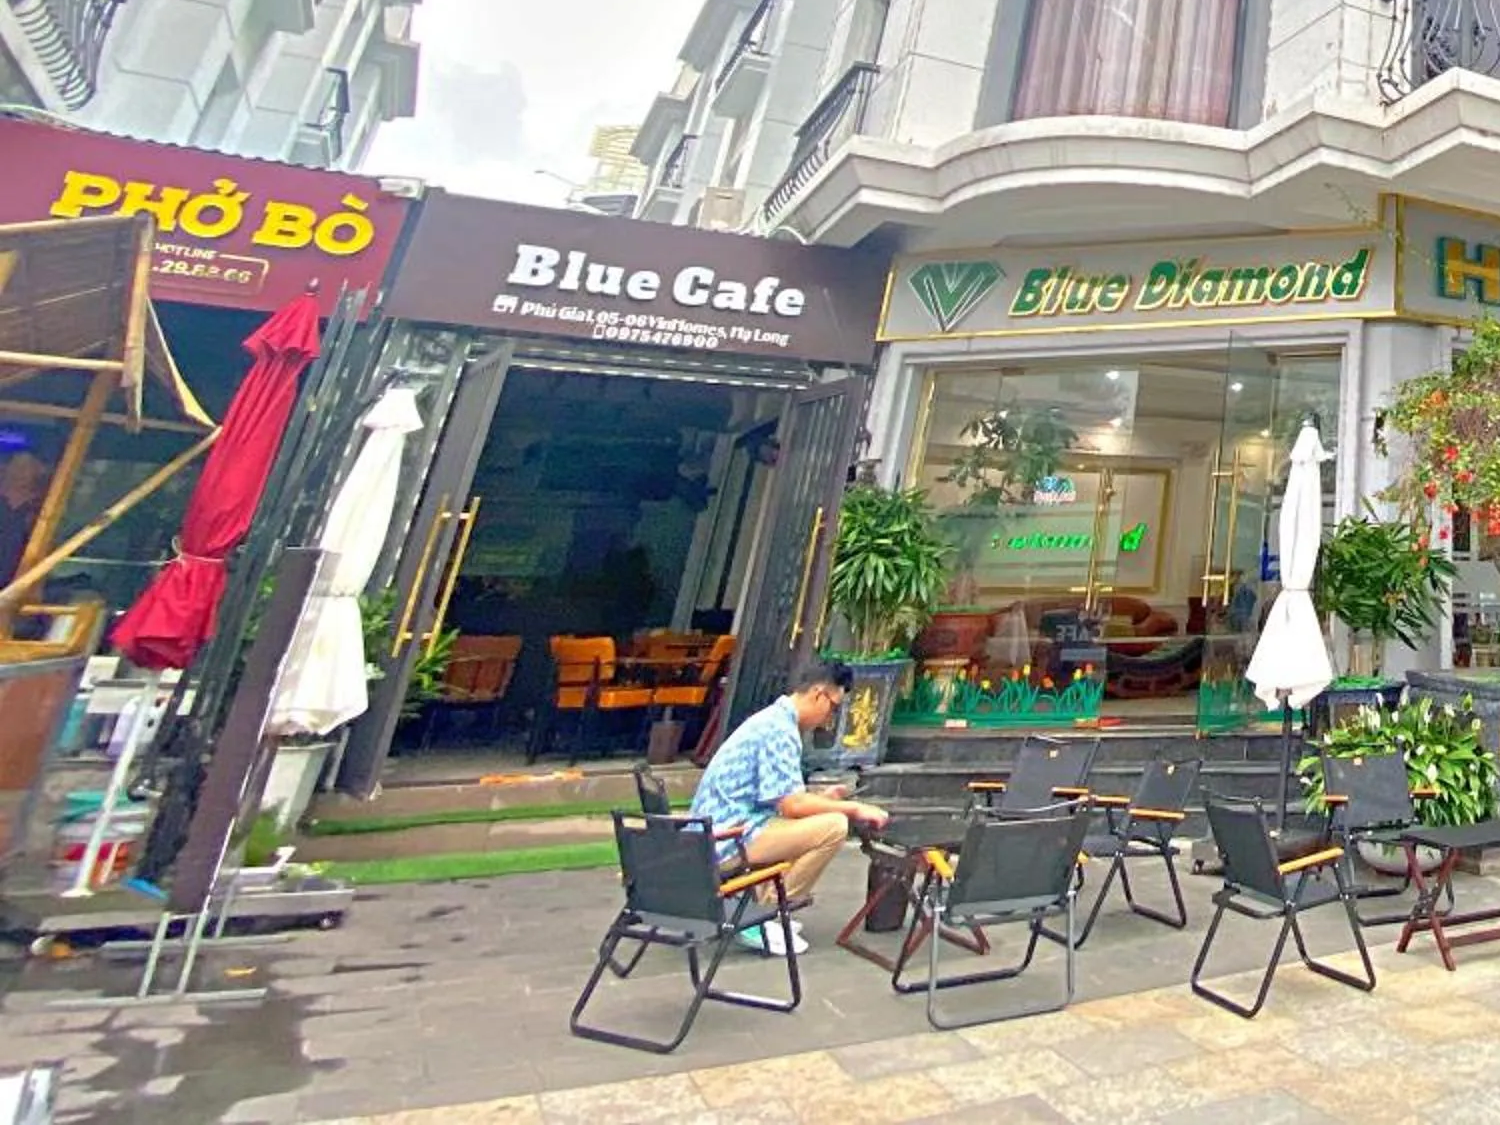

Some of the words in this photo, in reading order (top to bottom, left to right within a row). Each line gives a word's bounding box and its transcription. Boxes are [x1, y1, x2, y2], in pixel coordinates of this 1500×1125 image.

[49, 170, 251, 239] PHỞ
[252, 193, 375, 256] BÒ
[507, 244, 661, 300] Blue
[672, 266, 805, 316] Cafe
[1008, 265, 1132, 317] Blue
[1134, 246, 1374, 310] Diamond
[754, 329, 792, 347] Long
